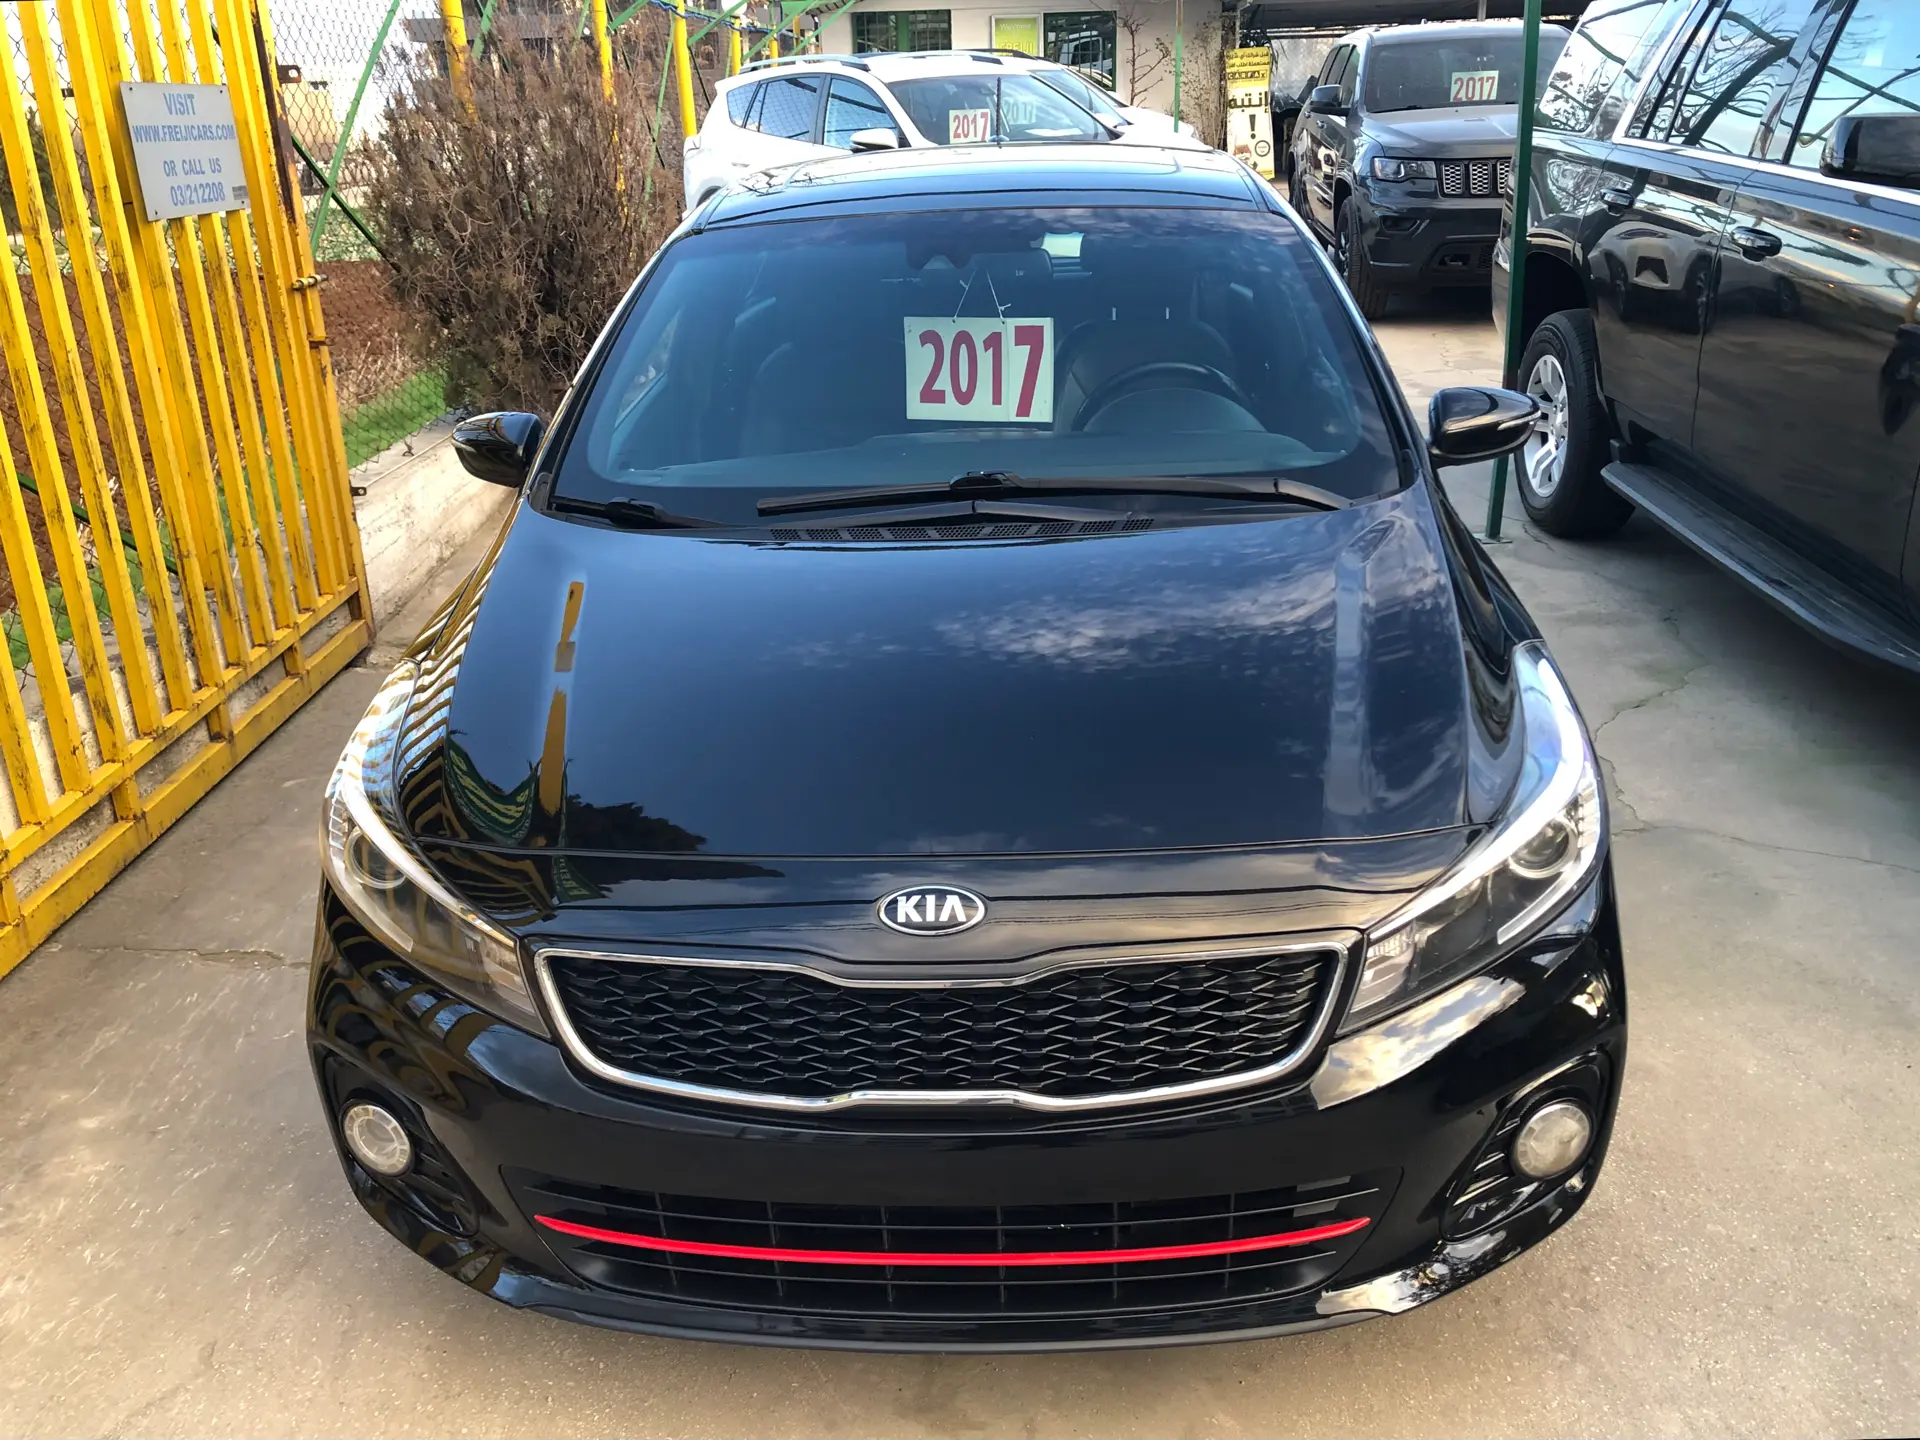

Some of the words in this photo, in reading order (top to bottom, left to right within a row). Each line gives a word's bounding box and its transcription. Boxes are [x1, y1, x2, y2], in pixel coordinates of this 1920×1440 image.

[1228, 71, 1266, 80] CARFAX
[1453, 76, 1496, 102] 2017
[163, 93, 195, 115] VISIT
[132, 125, 235, 143] WWW.FREIJICARS.COM
[953, 112, 989, 142] 2017
[163, 160, 178, 177] OR
[182, 158, 206, 176] CALL
[209, 157, 222, 174] US
[171, 182, 225, 206] 03/212208
[919, 325, 1045, 418] 2017
[896, 894, 967, 923] KIA
